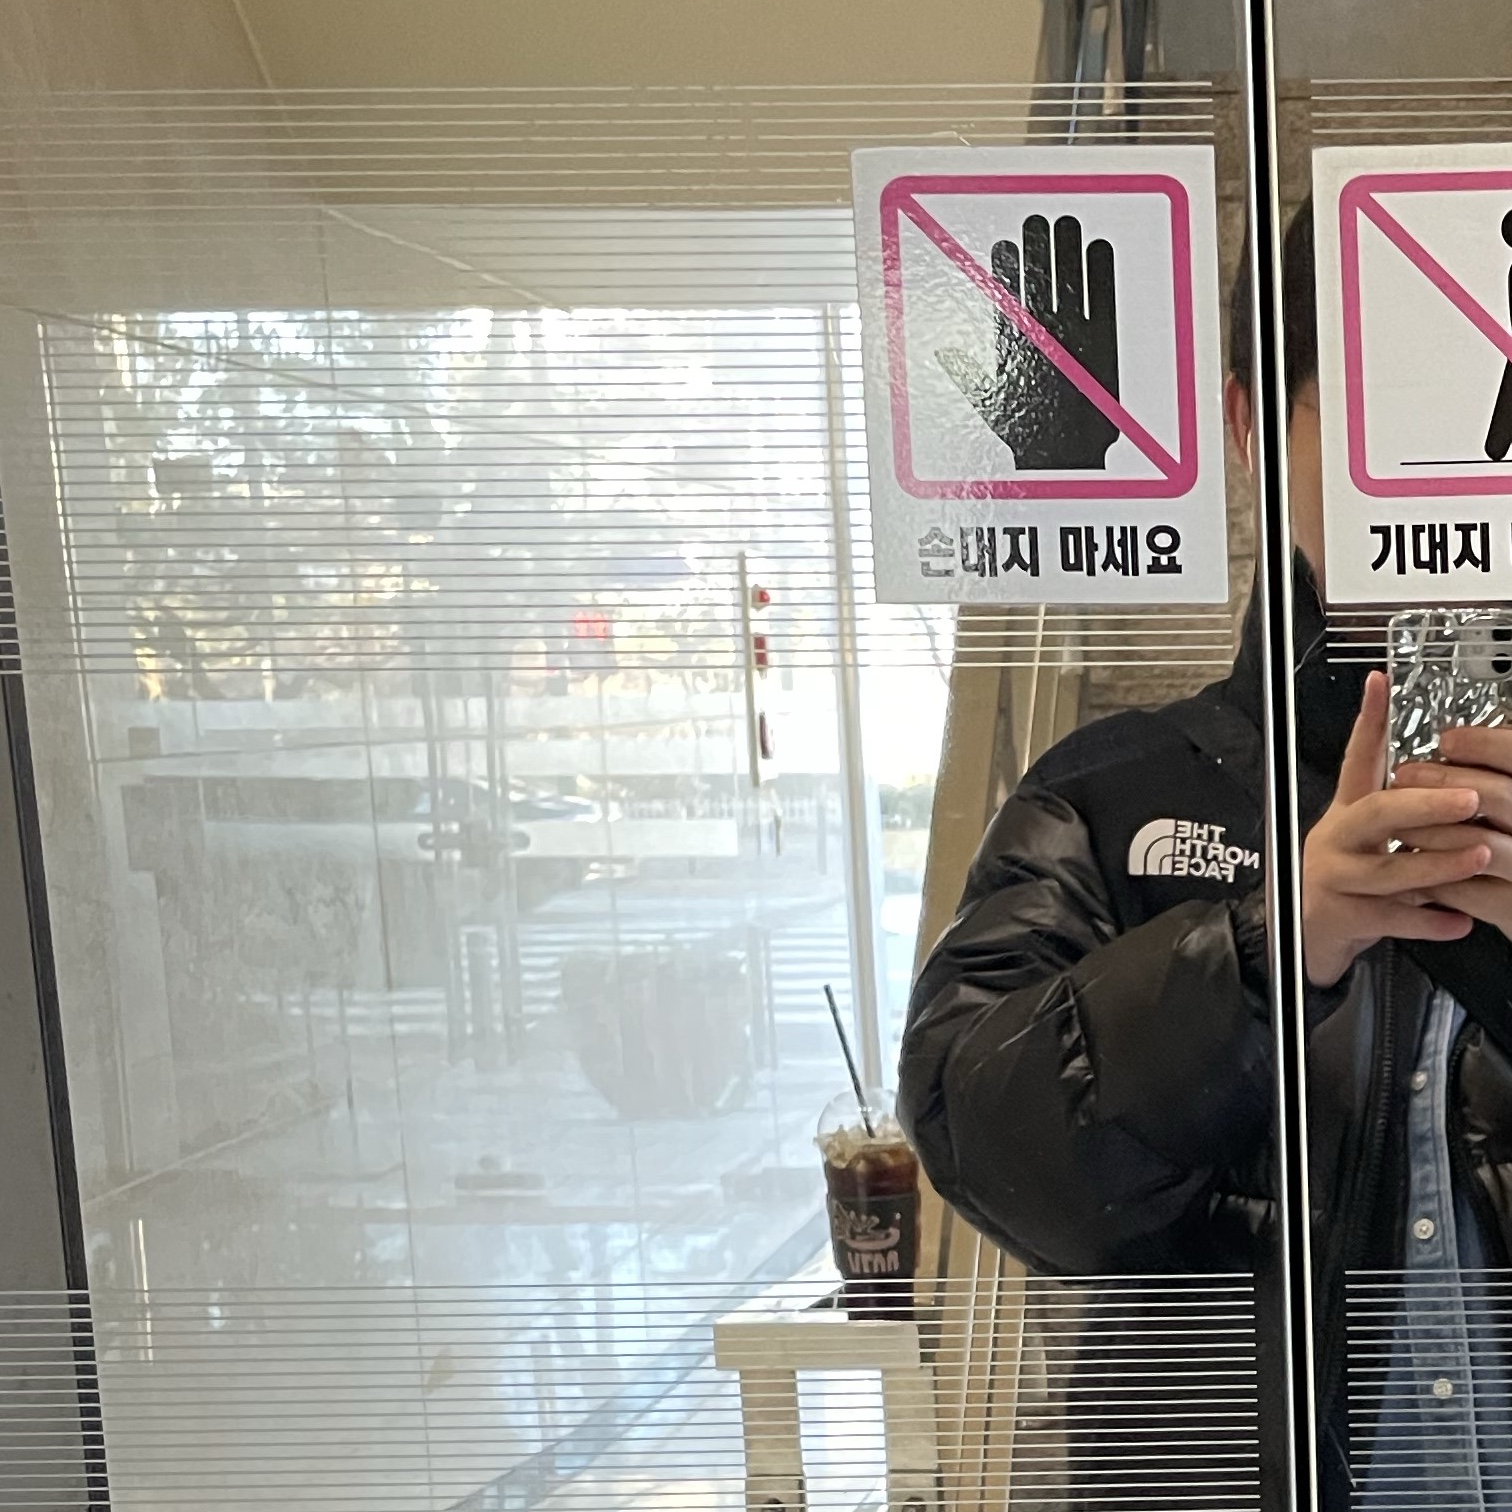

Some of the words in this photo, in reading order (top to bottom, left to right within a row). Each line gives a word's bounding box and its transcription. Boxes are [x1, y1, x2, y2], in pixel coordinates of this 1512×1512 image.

[917, 525, 1040, 578] 손대지
[1059, 524, 1183, 577] 마세요
[1369, 522, 1491, 576] 기대지
